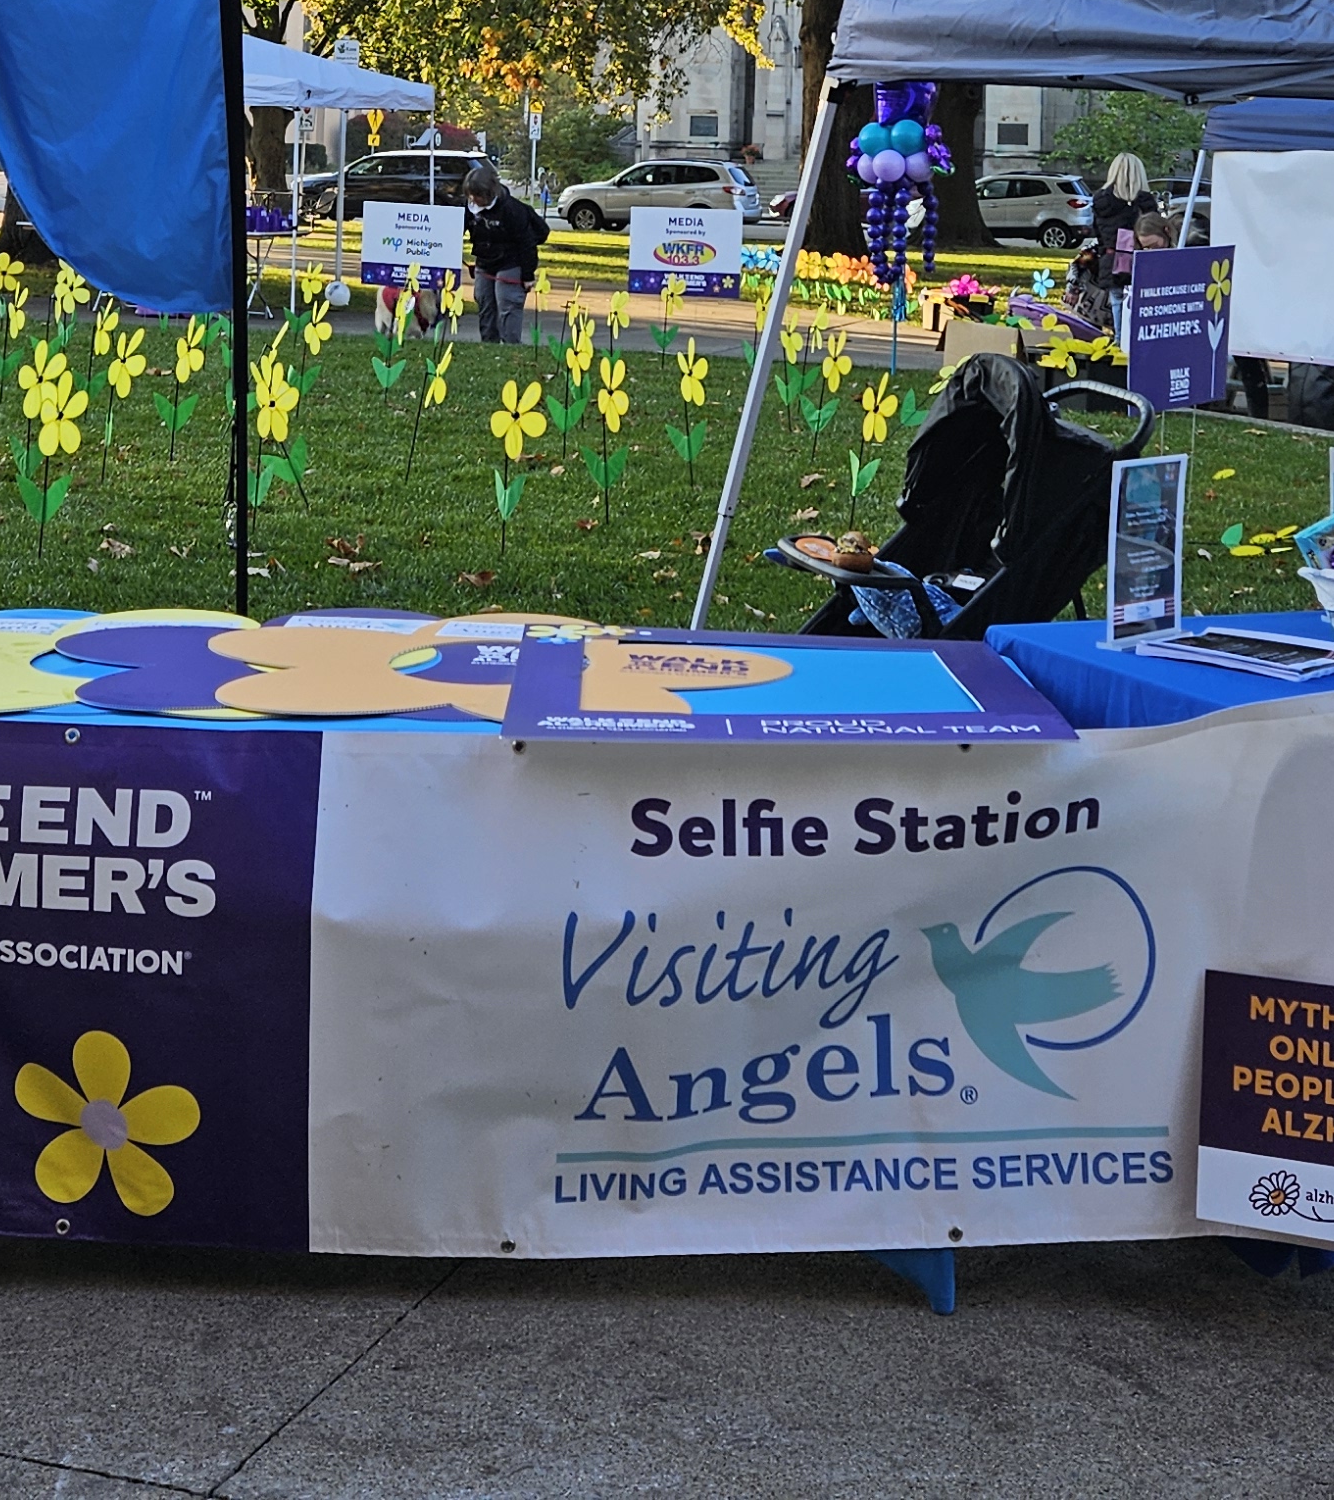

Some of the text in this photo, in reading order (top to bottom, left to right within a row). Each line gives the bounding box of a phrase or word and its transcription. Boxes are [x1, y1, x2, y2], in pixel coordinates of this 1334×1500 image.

[398, 213, 429, 223] MEDIA
[668, 217, 704, 226] MEDIA
[407, 239, 443, 249] Michigan
[662, 243, 704, 255] WKFR
[406, 248, 430, 256] Public
[667, 255, 700, 265] 103.3
[1144, 283, 1205, 297] WALK BECAUSE CARE
[1139, 302, 1204, 317] FOR SOMEONE WITH
[1138, 320, 1202, 341] ALZHEIMER'S.
[1170, 367, 1190, 379] WALK
[760, 719, 886, 727] PROUD
[762, 725, 1041, 734] NATIONAL TEAM
[630, 790, 1100, 857] Selfie Station
[562, 907, 899, 1030] Visiting
[554, 1149, 1174, 1204] LIVING ASSISTANCE SERVICES
